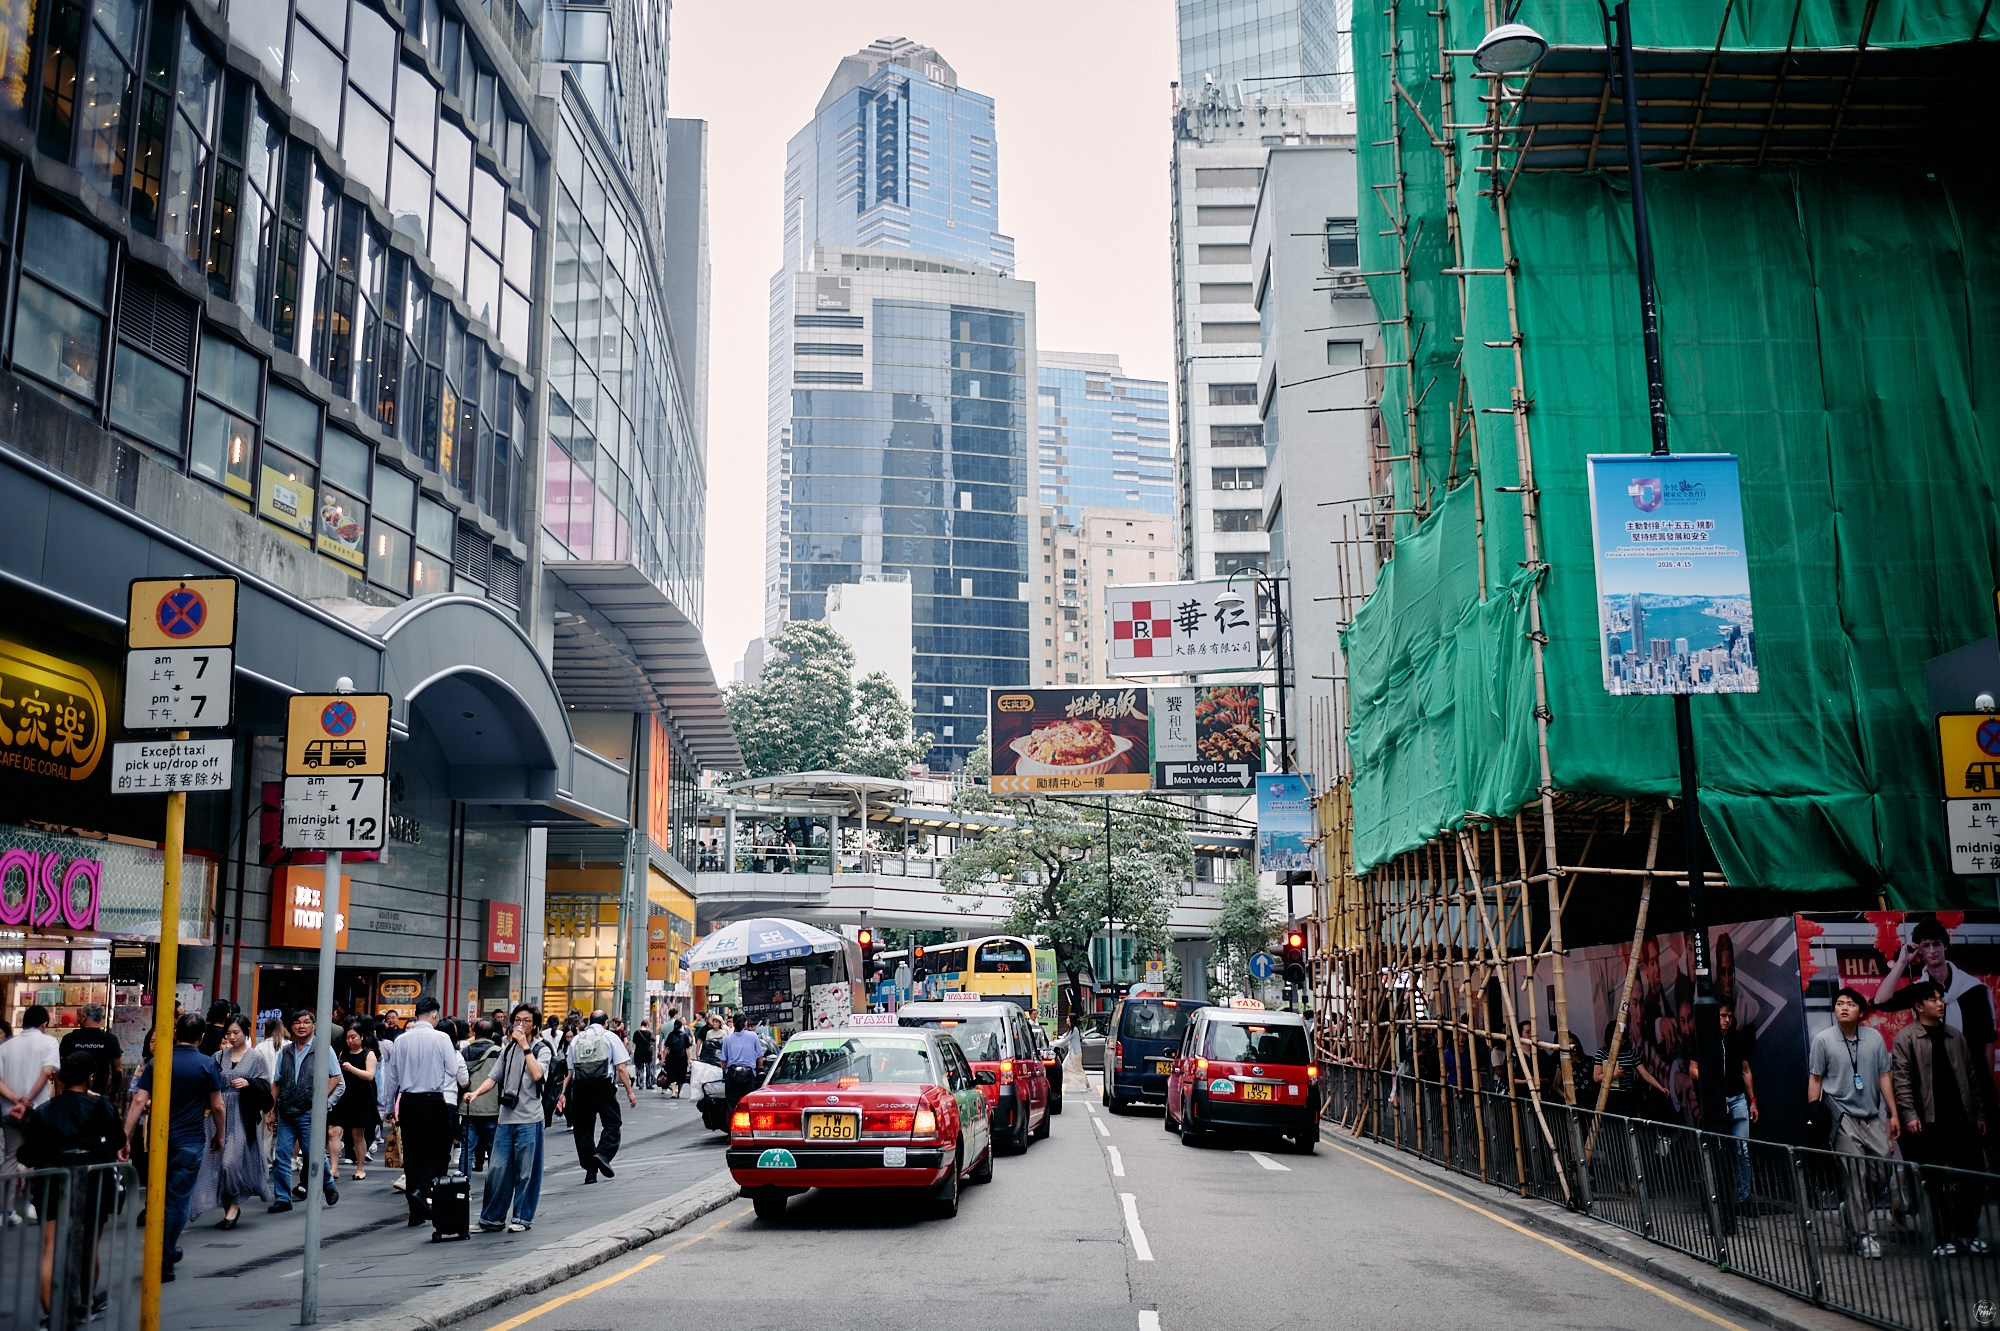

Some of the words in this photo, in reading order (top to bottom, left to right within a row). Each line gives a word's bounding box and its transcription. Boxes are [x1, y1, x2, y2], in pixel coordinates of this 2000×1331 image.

[1626, 521, 1714, 531] 主動對接「十五五」規劃
[1632, 532, 1708, 541] 堅持統籌發展和安全
[1173, 599, 1250, 639] 華仁
[1175, 641, 1251, 656] 大藥房有限公司
[154, 656, 172, 664] am
[193, 656, 209, 679] 7
[150, 669, 175, 681] 上午
[152, 695, 169, 705] pm
[190, 695, 207, 718] 7
[1065, 688, 1149, 720] 招牌焗飯
[148, 709, 173, 720] 下午
[141, 746, 181, 757] Except
[184, 744, 206, 755] taxi
[0, 750, 21, 769] AFÉ
[23, 756, 36, 773] DE
[38, 760, 69, 780] CORAL
[125, 760, 149, 772] pick
[153, 757, 199, 772] up/drop
[202, 756, 219, 767] off
[1187, 763, 1217, 773] Level
[1218, 763, 1225, 773] 2
[118, 772, 224, 789] 的士上落客除外
[1173, 776, 1192, 784] Man
[1193, 776, 1211, 784] Yee
[1212, 775, 1238, 784] Arcade
[302, 789, 329, 801] 上午
[307, 777, 325, 785] am
[348, 778, 364, 801] 7
[1972, 802, 1992, 811] am
[287, 814, 340, 826] midnight
[347, 817, 377, 841] 12
[1967, 815, 1999, 828] 上午
[299, 829, 327, 841] 午夜
[496, 911, 514, 938] 惠康
[493, 940, 515, 954] wellcome
[701, 961, 719, 969] 2116
[721, 957, 738, 966] 1112
[1845, 958, 1880, 976] HLA
[946, 992, 978, 1000] TAXI
[1235, 999, 1261, 1008] TAXI
[853, 1014, 893, 1025] TAXI
[1251, 1084, 1264, 1093] MU
[1247, 1091, 1268, 1100] 1357
[823, 1114, 842, 1126] TW
[812, 1126, 851, 1138] 3090
